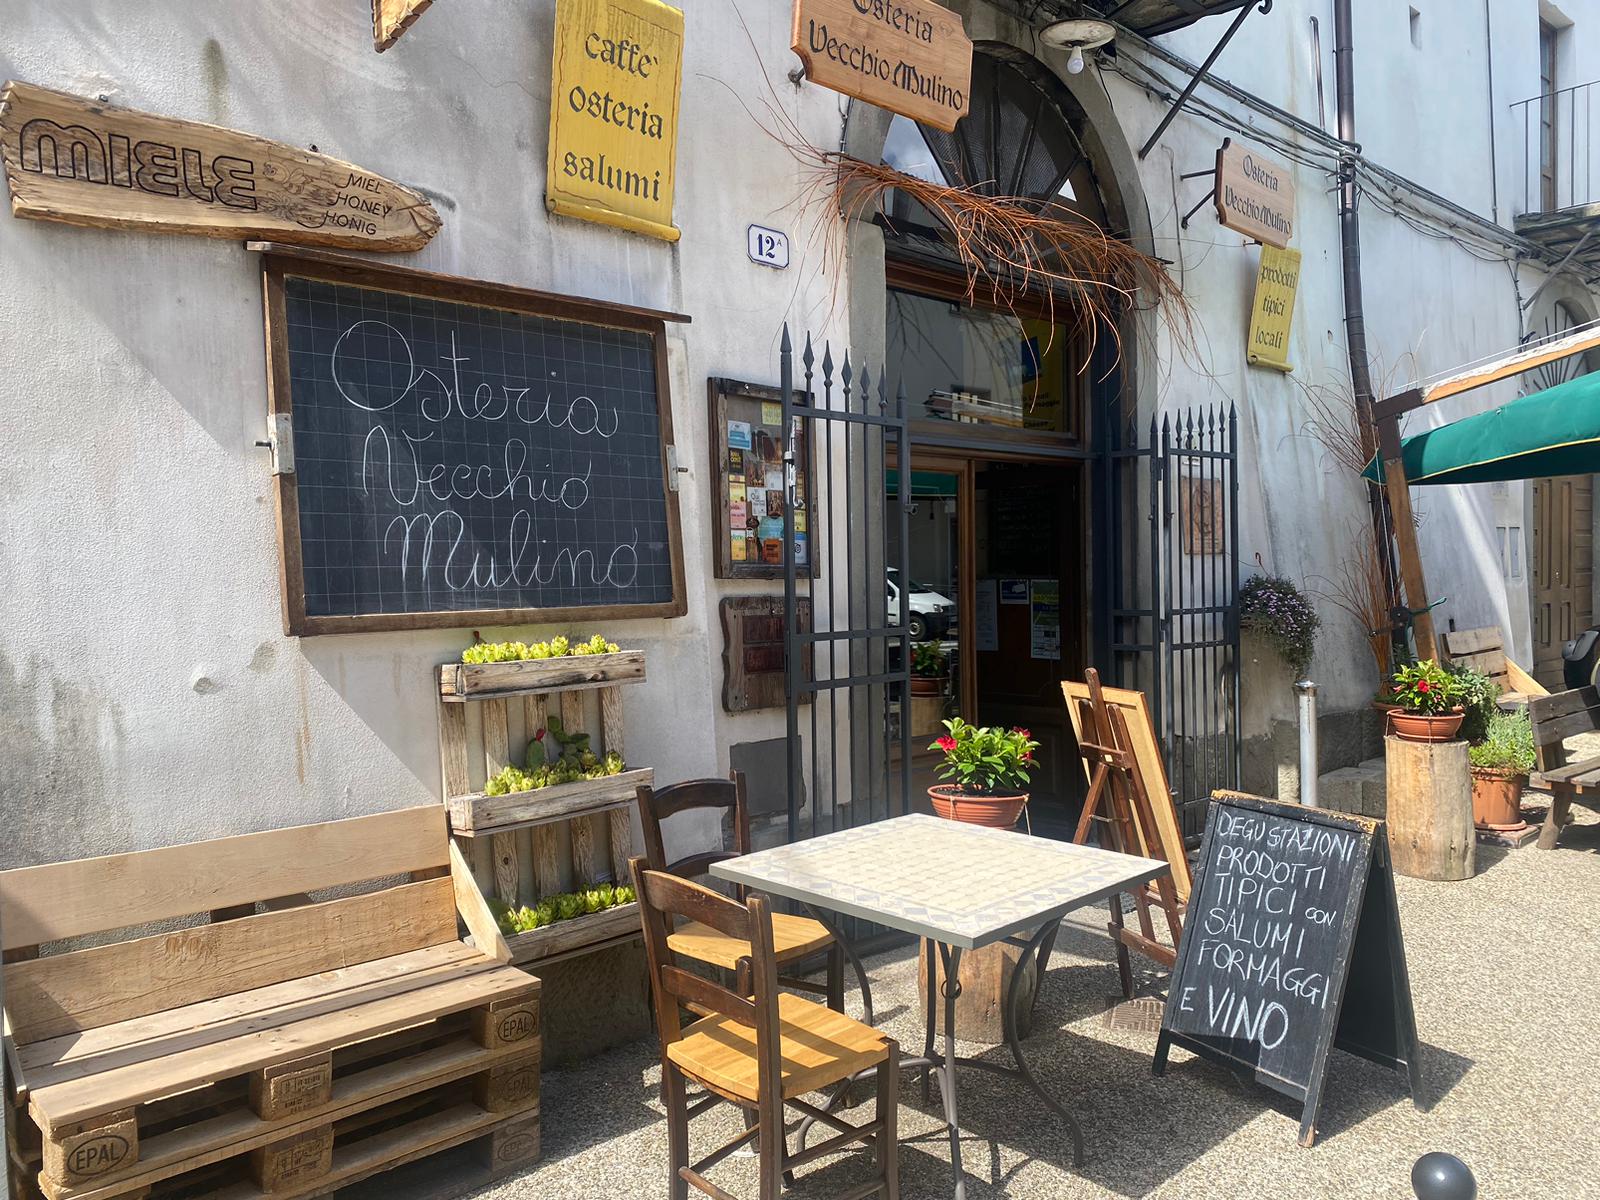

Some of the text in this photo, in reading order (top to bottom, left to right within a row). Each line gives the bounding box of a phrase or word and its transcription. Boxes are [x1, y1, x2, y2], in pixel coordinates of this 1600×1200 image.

[809, 19, 963, 111] Vecchio Mulino
[20, 118, 257, 210] MIELE
[335, 172, 382, 195] MIEL
[563, 151, 660, 202] salumi
[1242, 154, 1279, 193] Osteria
[296, 210, 377, 235] HONIG
[328, 191, 393, 219] HONEY
[1225, 185, 1292, 235] Vecchio Mulino
[1261, 264, 1298, 290] prodotti
[1262, 295, 1286, 317] tipici
[1255, 326, 1283, 350] locali
[331, 320, 620, 438] Osteria
[362, 424, 593, 510] Vecchio
[383, 509, 639, 591] Mulino
[1215, 872, 1297, 916] TIPICI
[1204, 907, 1306, 960] SALUMI
[1197, 939, 1331, 1010] FORMAGGI
[503, 1016, 529, 1039] EPAL
[1180, 984, 1290, 1050] E VINO
[76, 1142, 121, 1171] EPAL
